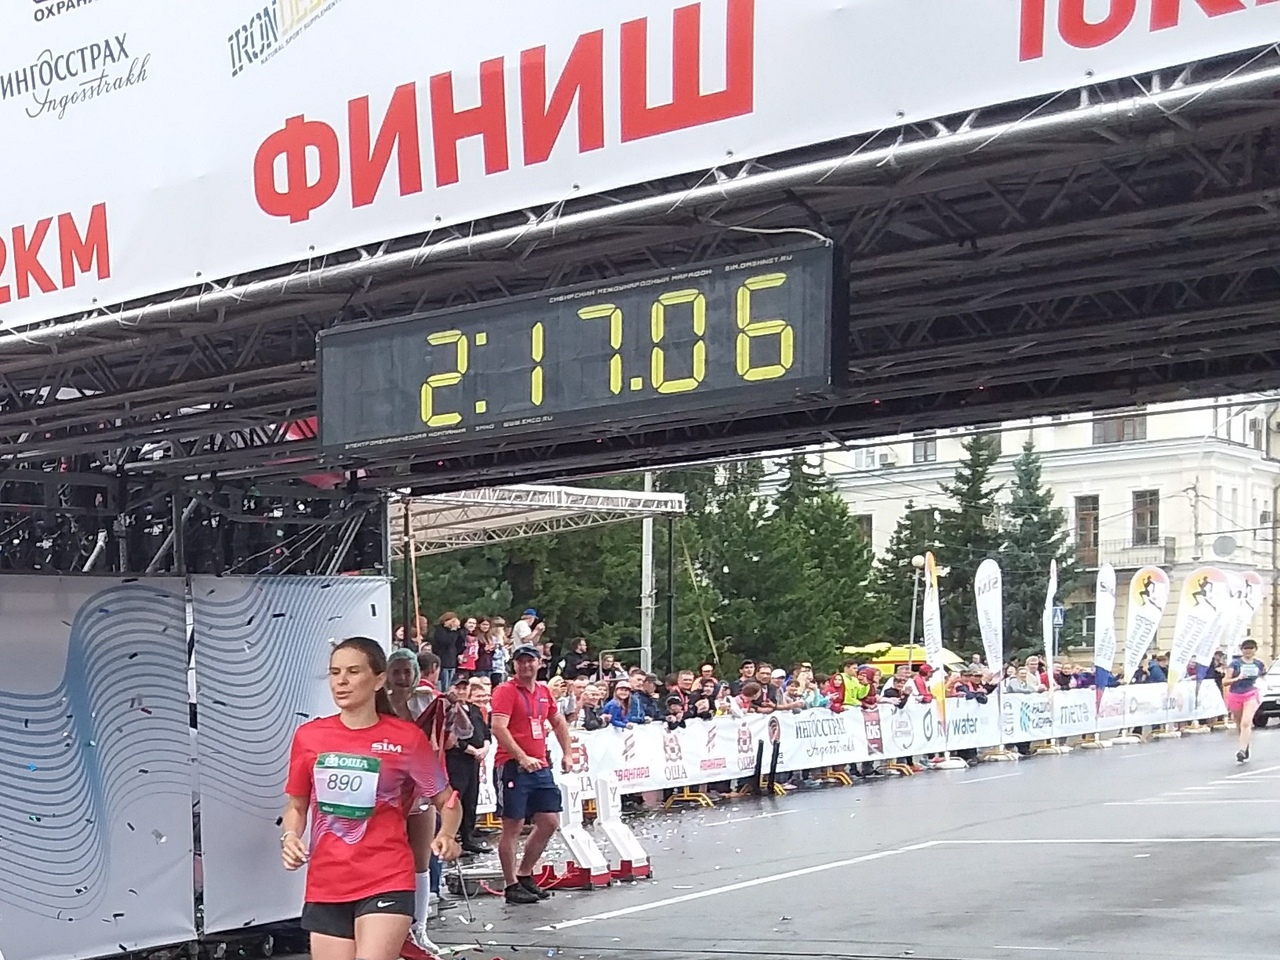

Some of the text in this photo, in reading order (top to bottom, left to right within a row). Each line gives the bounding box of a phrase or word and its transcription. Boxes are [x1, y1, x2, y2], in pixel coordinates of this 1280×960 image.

[0, 32, 130, 100] ИНГОССТРАХ
[25, 53, 151, 120] Ingosstrakh
[254, 0, 755, 224] ФИНИШ
[421, 272, 794, 427] 2:17.06
[326, 773, 363, 792] 890
[340, 757, 369, 769] ОША
[664, 765, 688, 781] ОША
